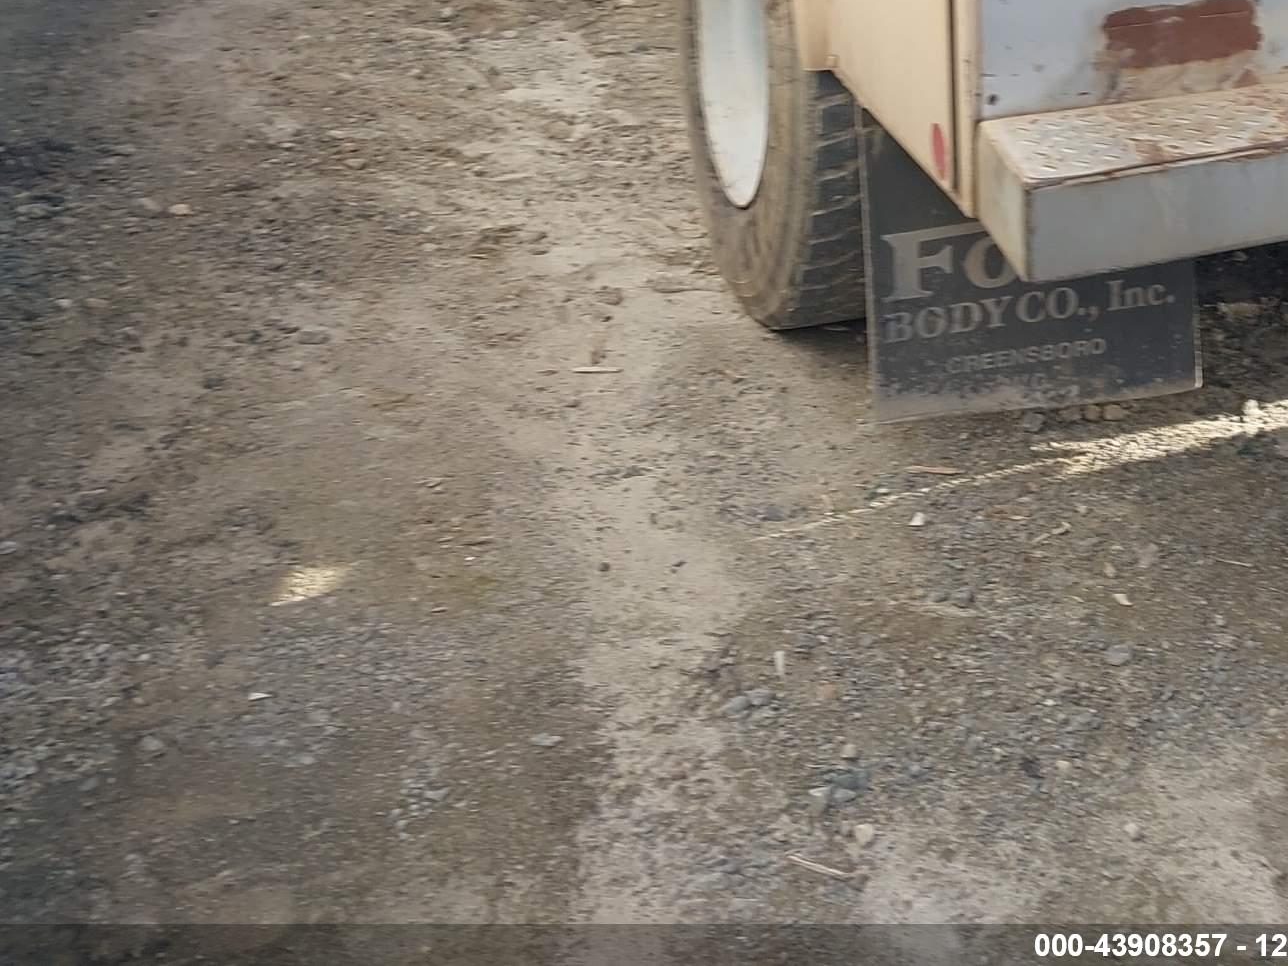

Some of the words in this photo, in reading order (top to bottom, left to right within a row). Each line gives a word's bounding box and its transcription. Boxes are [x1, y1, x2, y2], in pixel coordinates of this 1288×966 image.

[882, 296, 1014, 345] BODY
[1105, 279, 1177, 312] Inc.
[946, 337, 1108, 375] GREENSBORO
